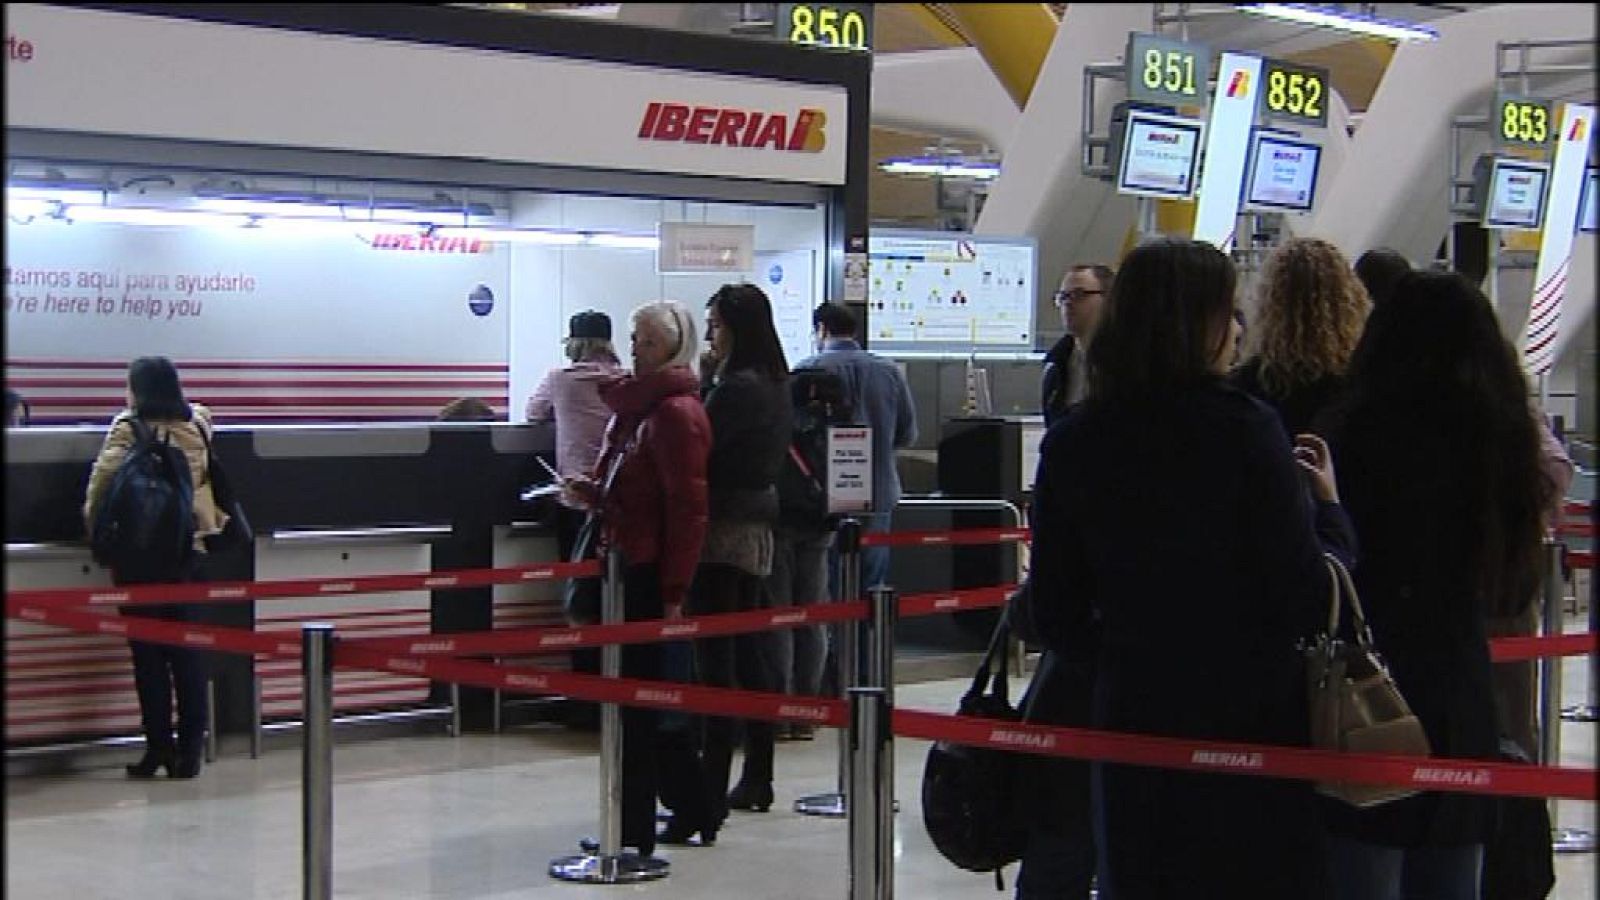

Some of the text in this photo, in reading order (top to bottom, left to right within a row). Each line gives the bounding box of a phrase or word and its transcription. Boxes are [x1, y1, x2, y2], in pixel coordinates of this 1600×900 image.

[791, 5, 865, 49] 850
[1143, 49, 1196, 95] 851
[1268, 71, 1322, 118] 852
[638, 102, 788, 151] IBERIA
[1503, 102, 1547, 142] 853
[175, 272, 256, 295] ayudarle
[43, 294, 91, 314] here
[95, 295, 116, 315] to
[119, 296, 163, 320] help
[167, 299, 203, 320] you
[989, 730, 1044, 748] IBERIA
[1191, 750, 1250, 767] IBERIA
[1412, 767, 1475, 785] IBERIA
